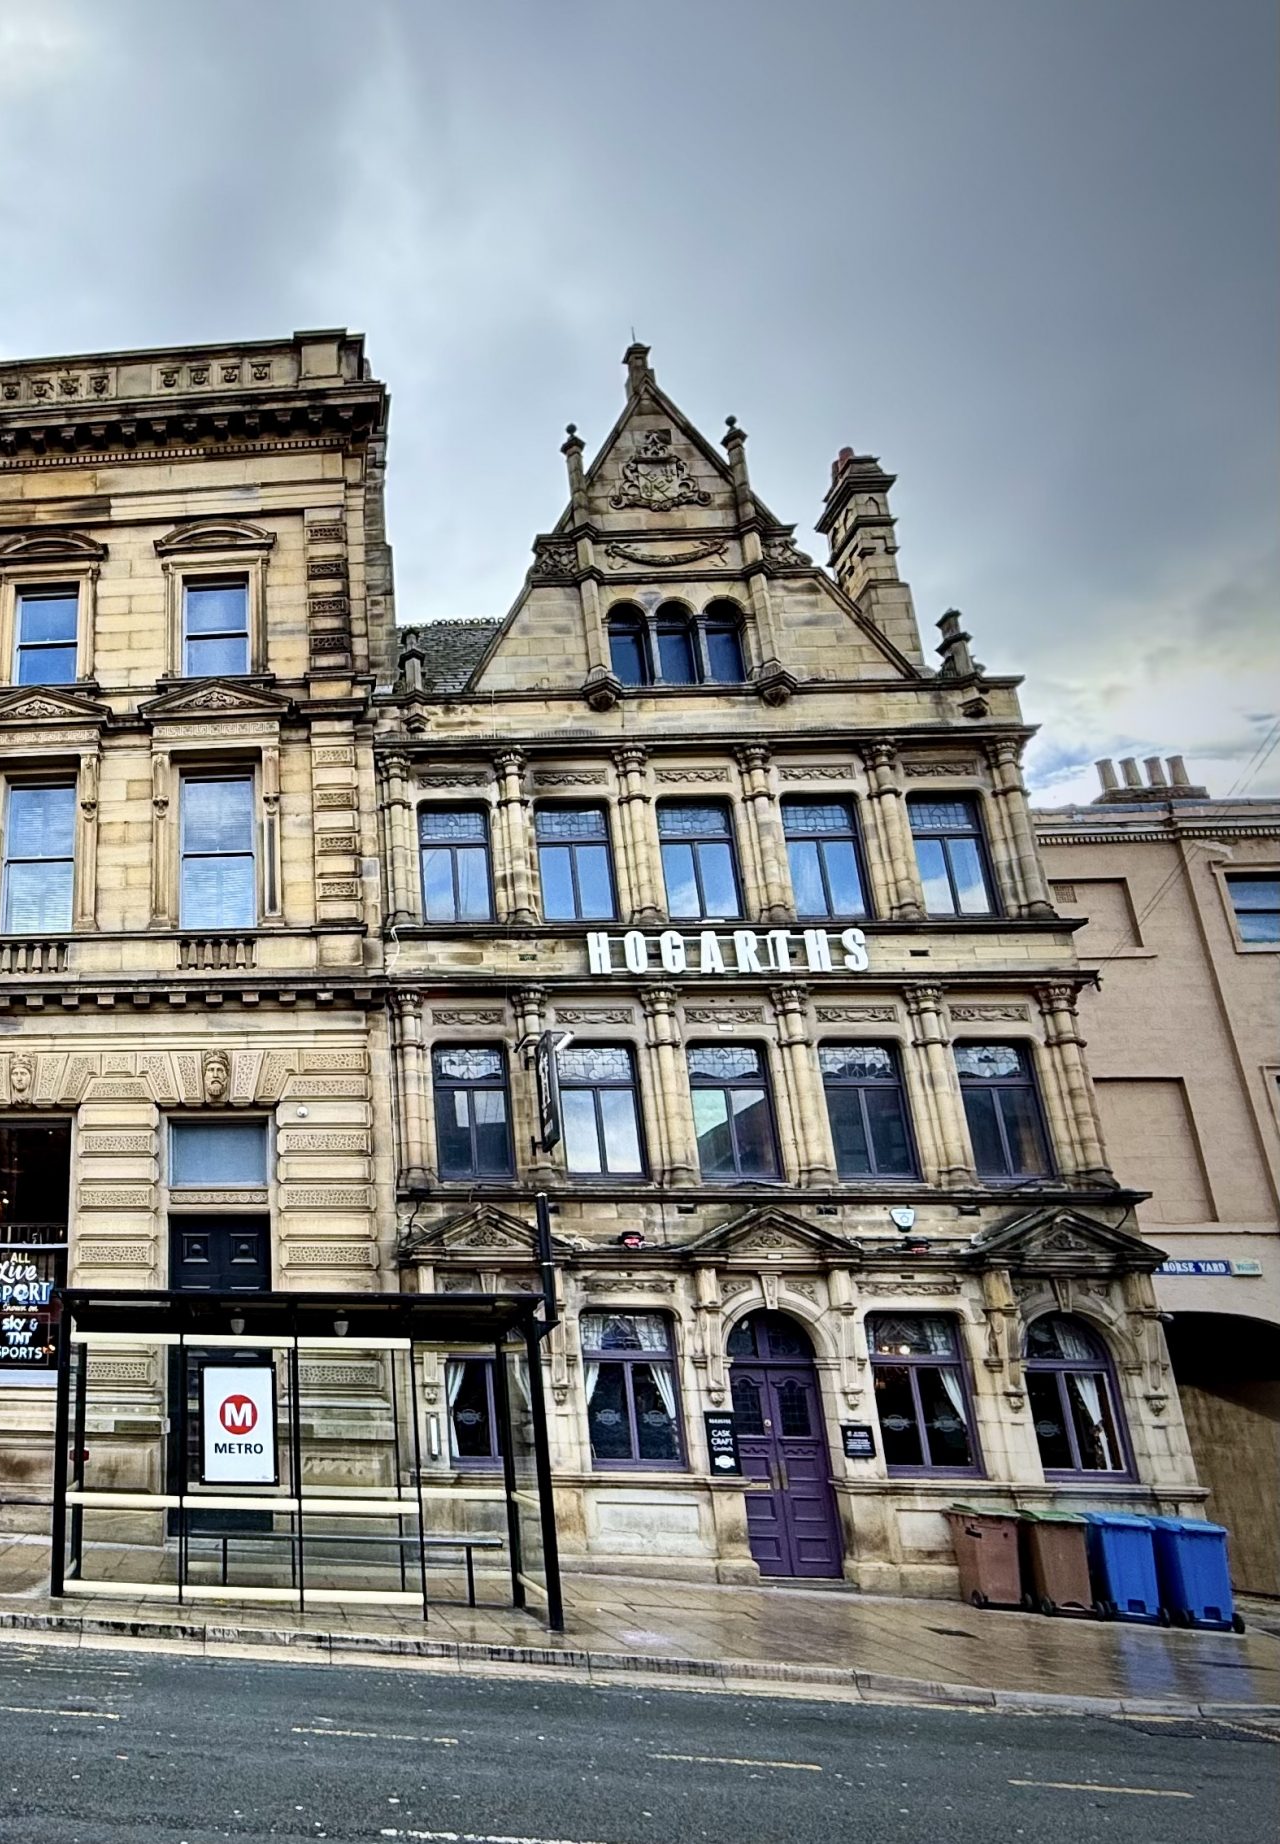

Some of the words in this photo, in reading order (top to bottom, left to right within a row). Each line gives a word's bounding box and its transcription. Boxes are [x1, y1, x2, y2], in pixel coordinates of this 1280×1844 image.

[586, 928, 869, 975] HOGARTHS
[10, 1252, 31, 1264] ALL
[1162, 1262, 1196, 1273] HORSE
[1198, 1262, 1227, 1273] YARD
[5, 1331, 33, 1345] TNT
[224, 1402, 253, 1427] M
[214, 1442, 264, 1454] METRO
